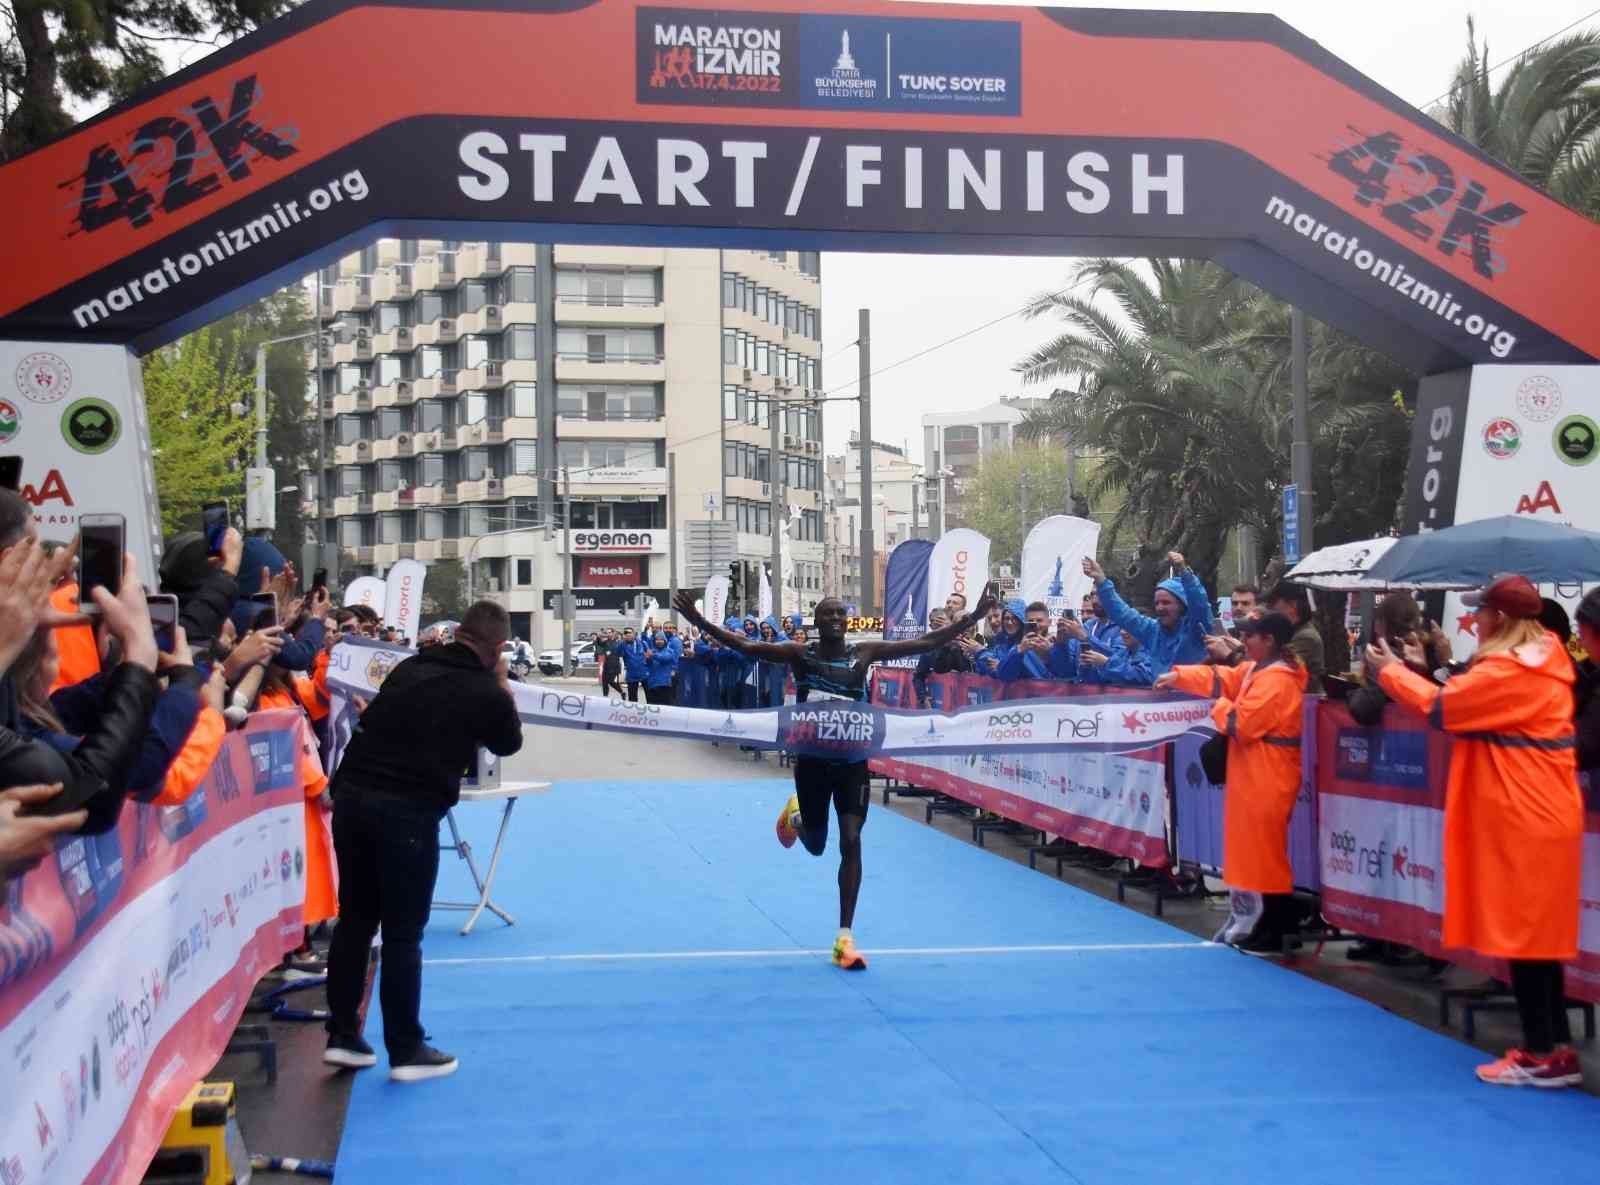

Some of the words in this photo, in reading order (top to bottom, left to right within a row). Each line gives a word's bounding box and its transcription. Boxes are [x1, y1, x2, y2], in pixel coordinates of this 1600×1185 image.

[655, 24, 781, 50] MARATON
[899, 74, 947, 93] TUNÇ
[950, 77, 1007, 93] SOYER
[72, 168, 370, 329] maratonizmir.org
[1264, 195, 1518, 358] maratonizmir.org
[575, 532, 653, 551] egemen
[588, 565, 634, 576] Miele
[791, 710, 874, 725] MARATON
[1056, 711, 1104, 738] nef
